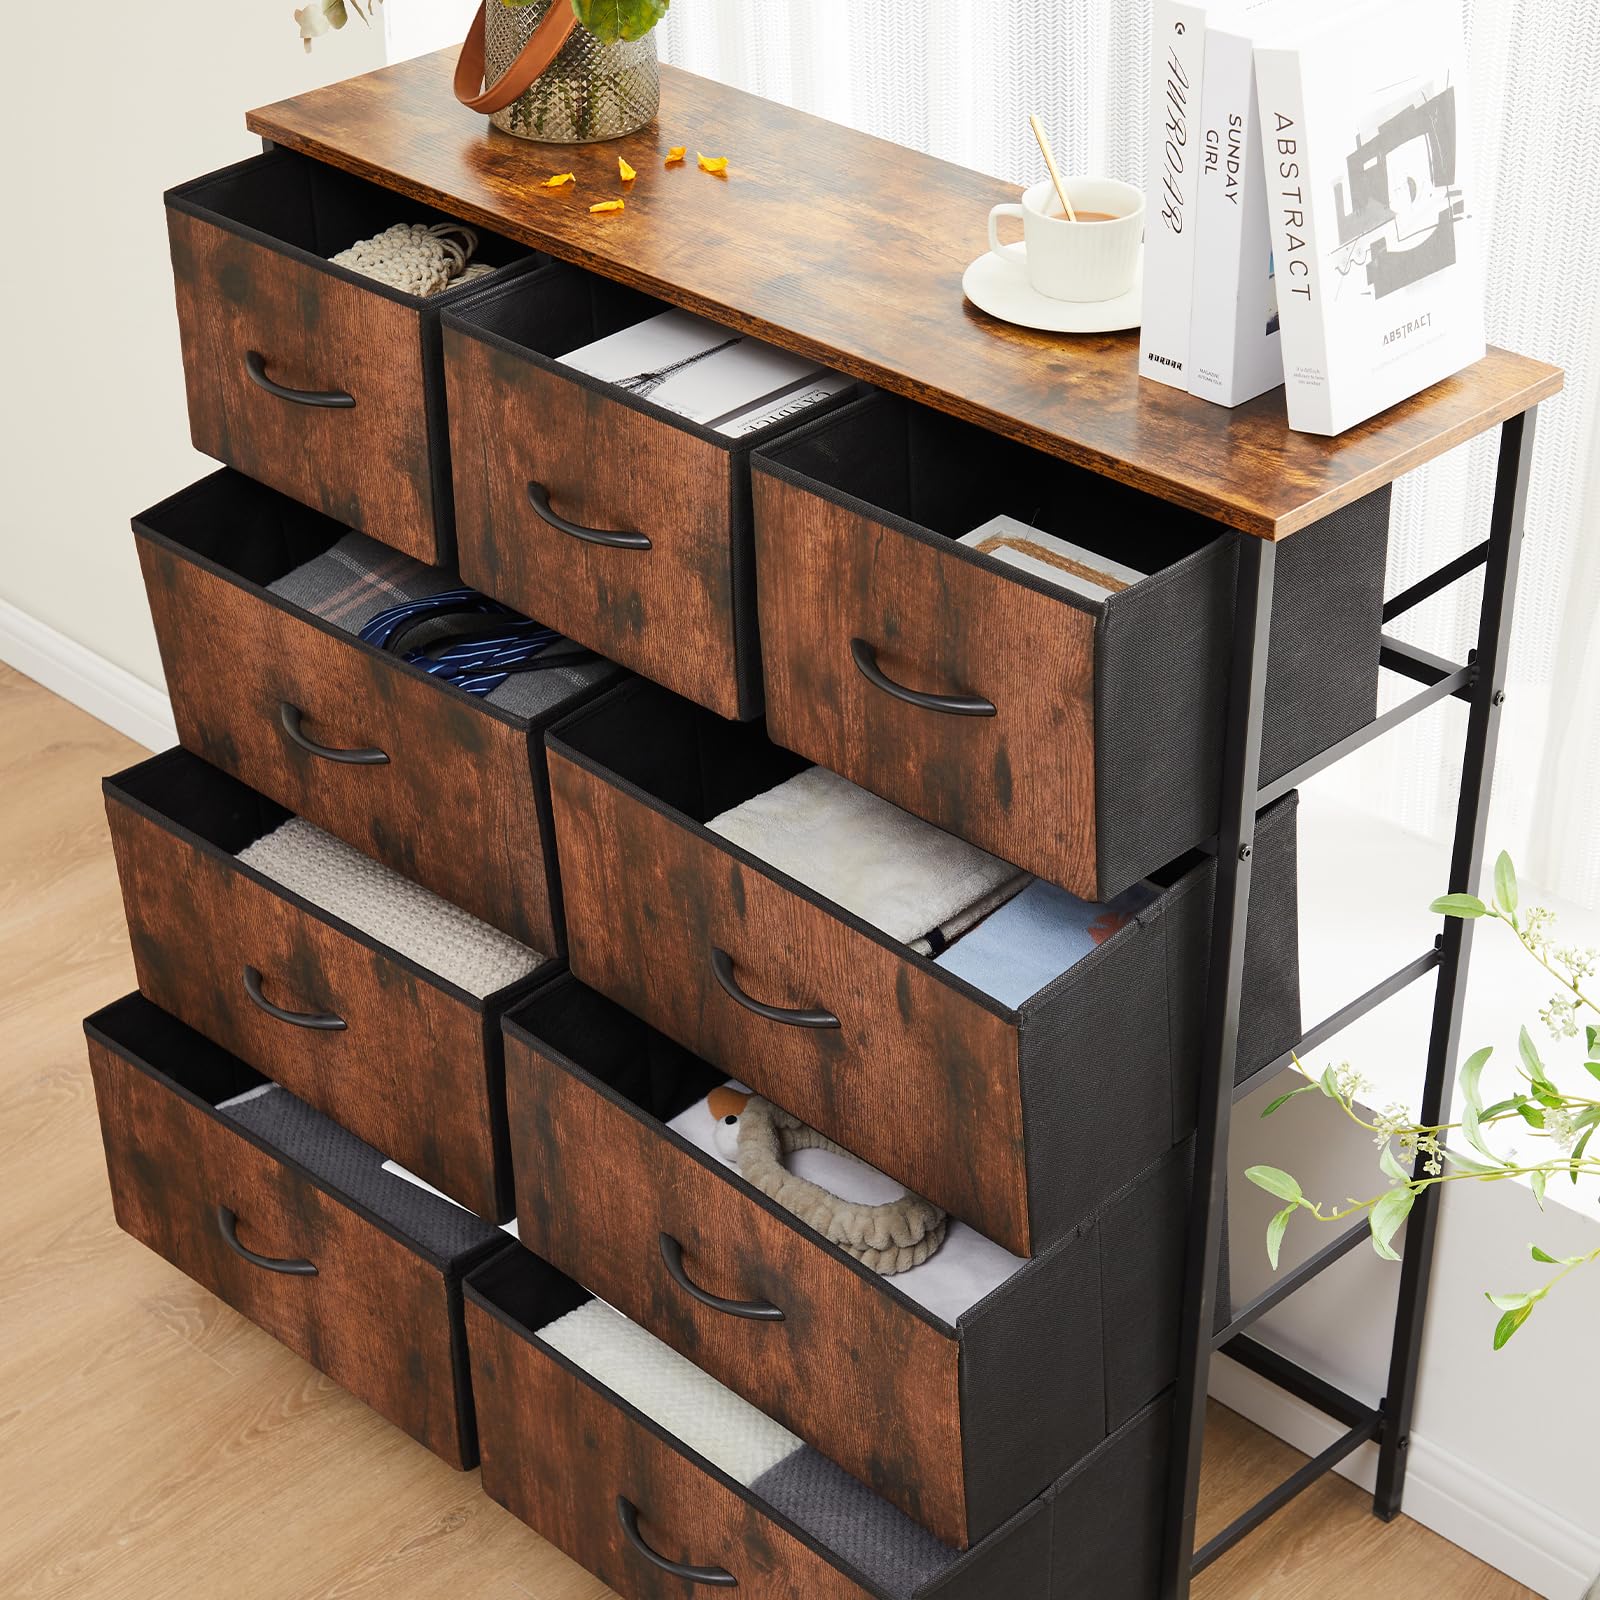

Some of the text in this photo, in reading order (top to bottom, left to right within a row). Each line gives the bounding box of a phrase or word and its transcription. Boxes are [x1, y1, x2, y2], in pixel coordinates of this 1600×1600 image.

[1204, 129, 1219, 175] GIRL
[1225, 113, 1243, 205] SUNDAY
[1274, 112, 1311, 301] ABSTRACT
[1382, 312, 1431, 347] ABSTRACT
